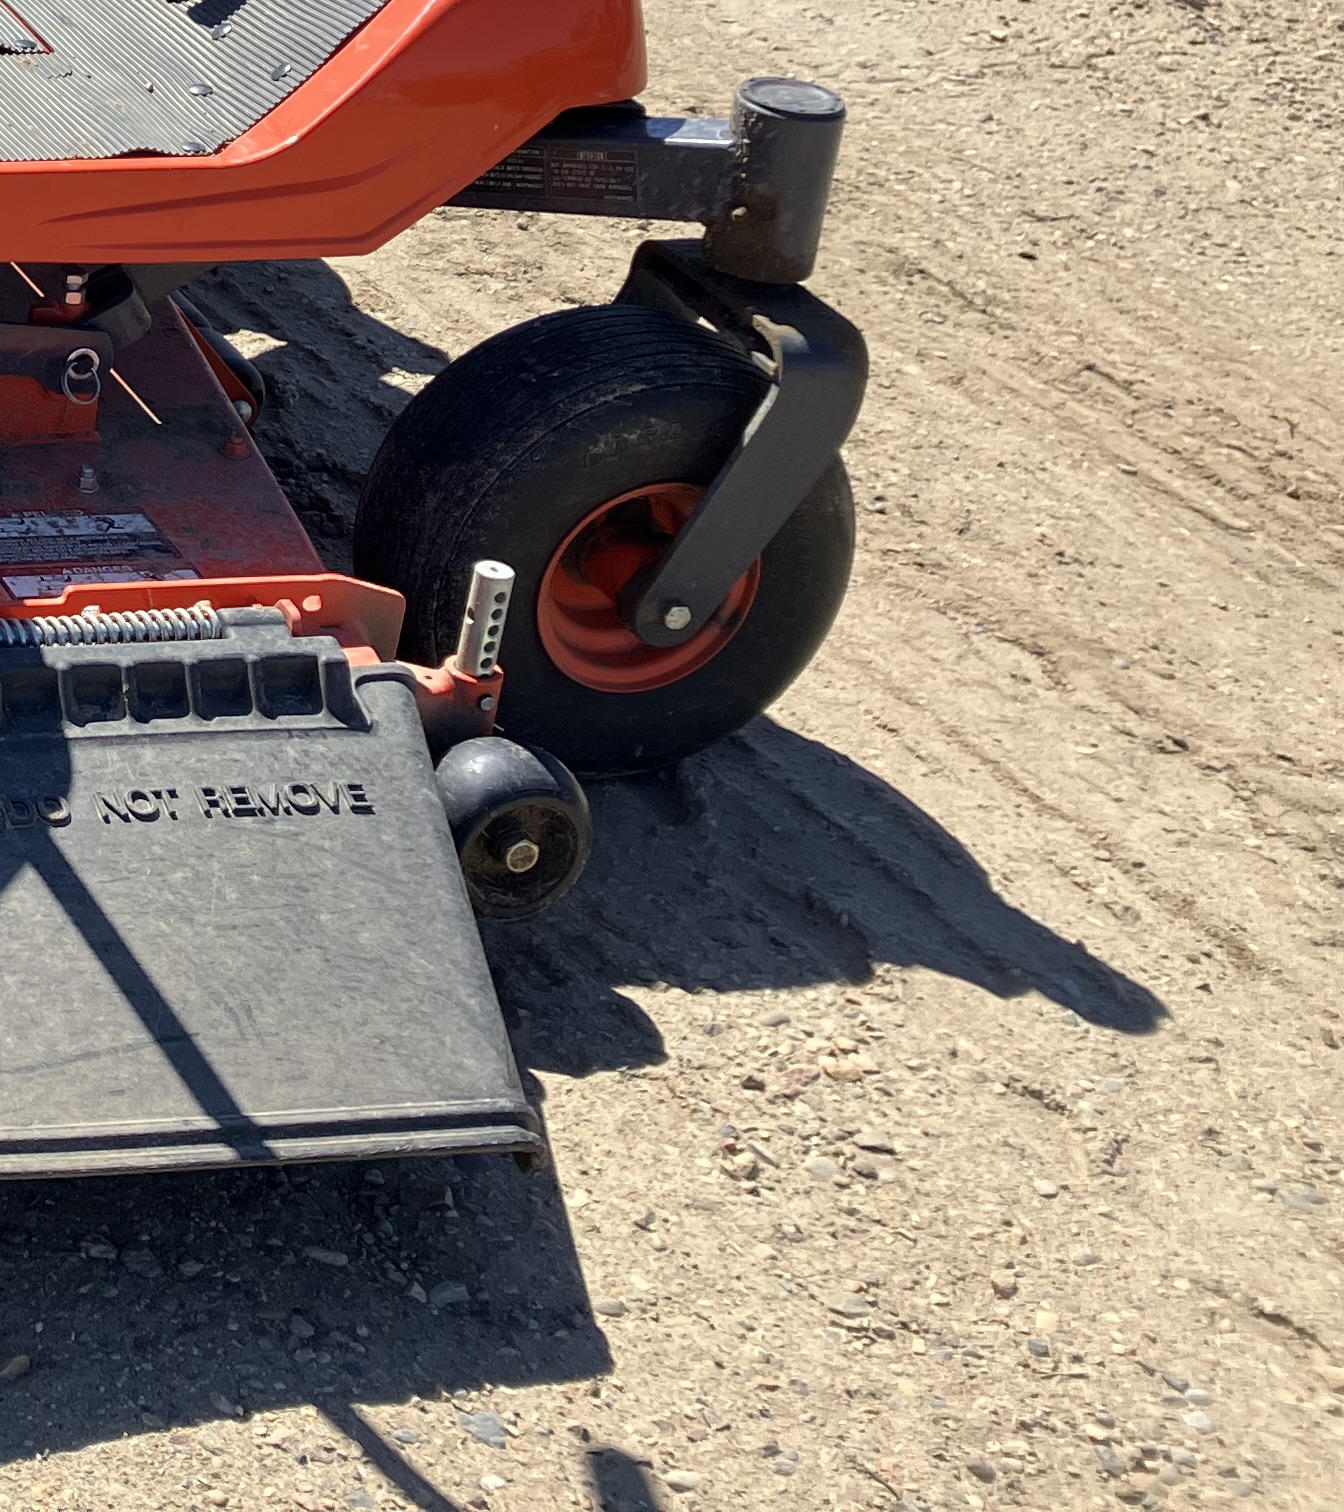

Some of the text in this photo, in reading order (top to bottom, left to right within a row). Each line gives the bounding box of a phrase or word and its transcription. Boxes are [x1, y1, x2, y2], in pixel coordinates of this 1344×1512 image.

[1, 780, 376, 829] DO NOT REMOVE
